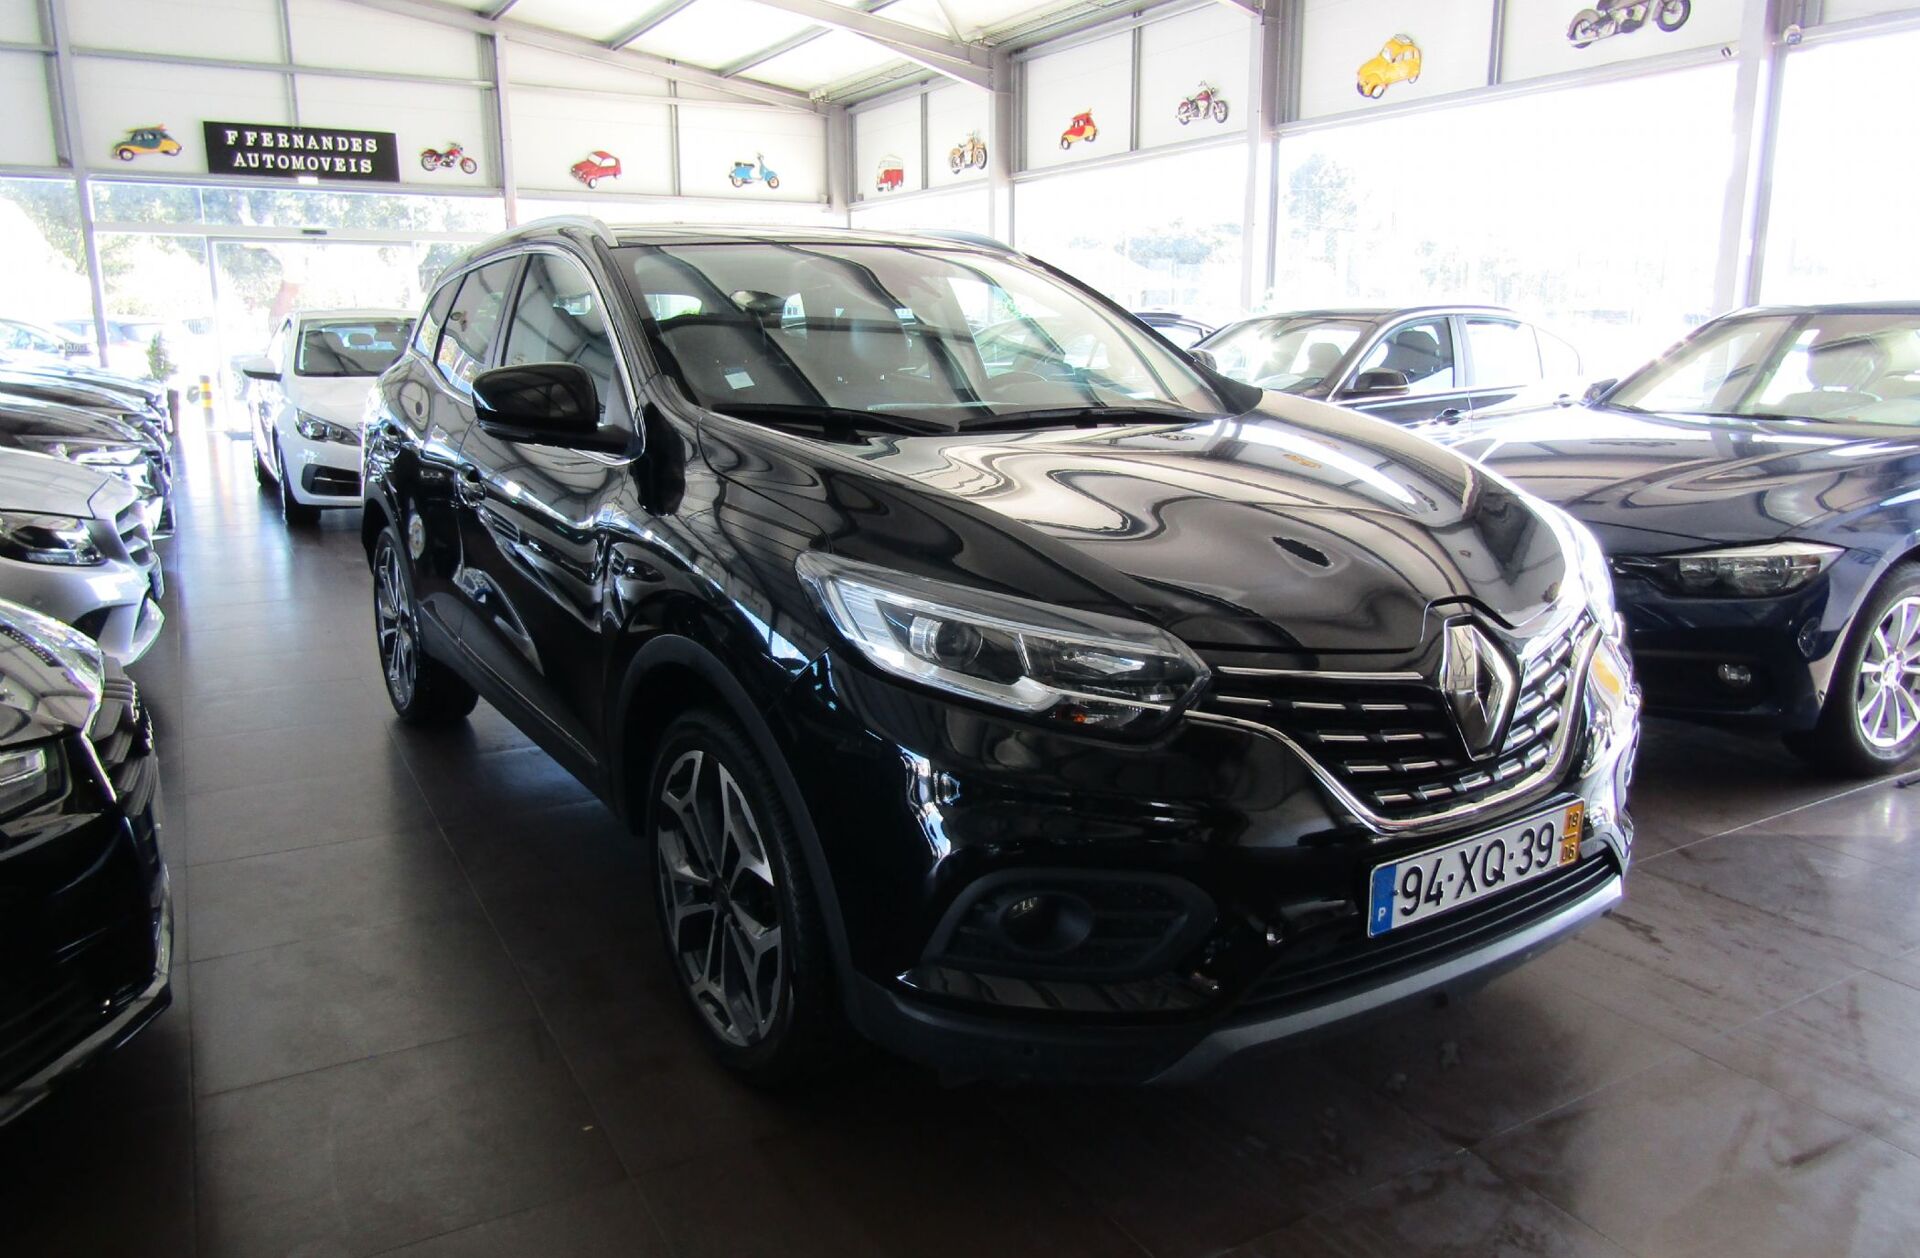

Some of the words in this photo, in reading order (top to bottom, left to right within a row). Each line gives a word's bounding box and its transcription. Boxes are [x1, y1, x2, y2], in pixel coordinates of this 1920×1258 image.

[225, 131, 238, 145] F
[245, 131, 377, 153] FERNANDES
[233, 152, 373, 173] AUTOMOVEIS
[1568, 811, 1580, 829] 19
[1377, 907, 1386, 922] P
